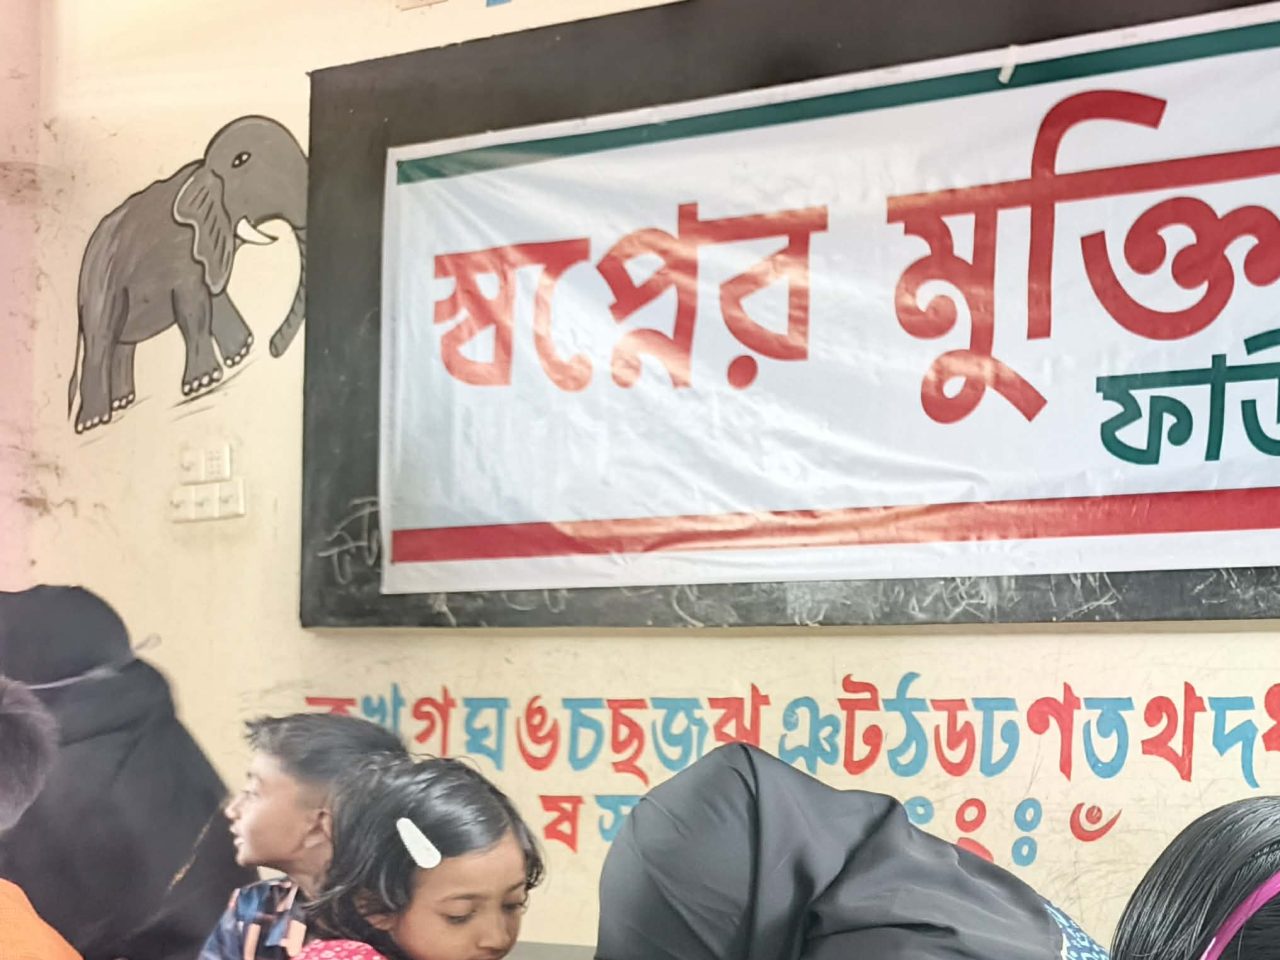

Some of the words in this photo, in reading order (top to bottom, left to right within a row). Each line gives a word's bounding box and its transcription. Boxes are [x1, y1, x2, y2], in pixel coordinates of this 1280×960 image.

[433, 202, 830, 393] স্বপ্নের
[412, 687, 458, 757] গ
[463, 697, 509, 771] ঘ
[516, 696, 560, 772] ঙ
[561, 697, 606, 771] চ
[606, 698, 649, 786] ছ
[650, 697, 708, 772] জ
[778, 697, 841, 774] ঞ
[838, 674, 884, 776] ট
[882, 671, 930, 777] ঠ
[931, 698, 977, 778] ড
[972, 697, 1020, 778] ঢ
[1027, 681, 1082, 782] ণ
[1083, 697, 1135, 779] ত
[1141, 681, 1206, 782] থ
[1208, 696, 1260, 789] দ
[539, 795, 584, 853] ষ
